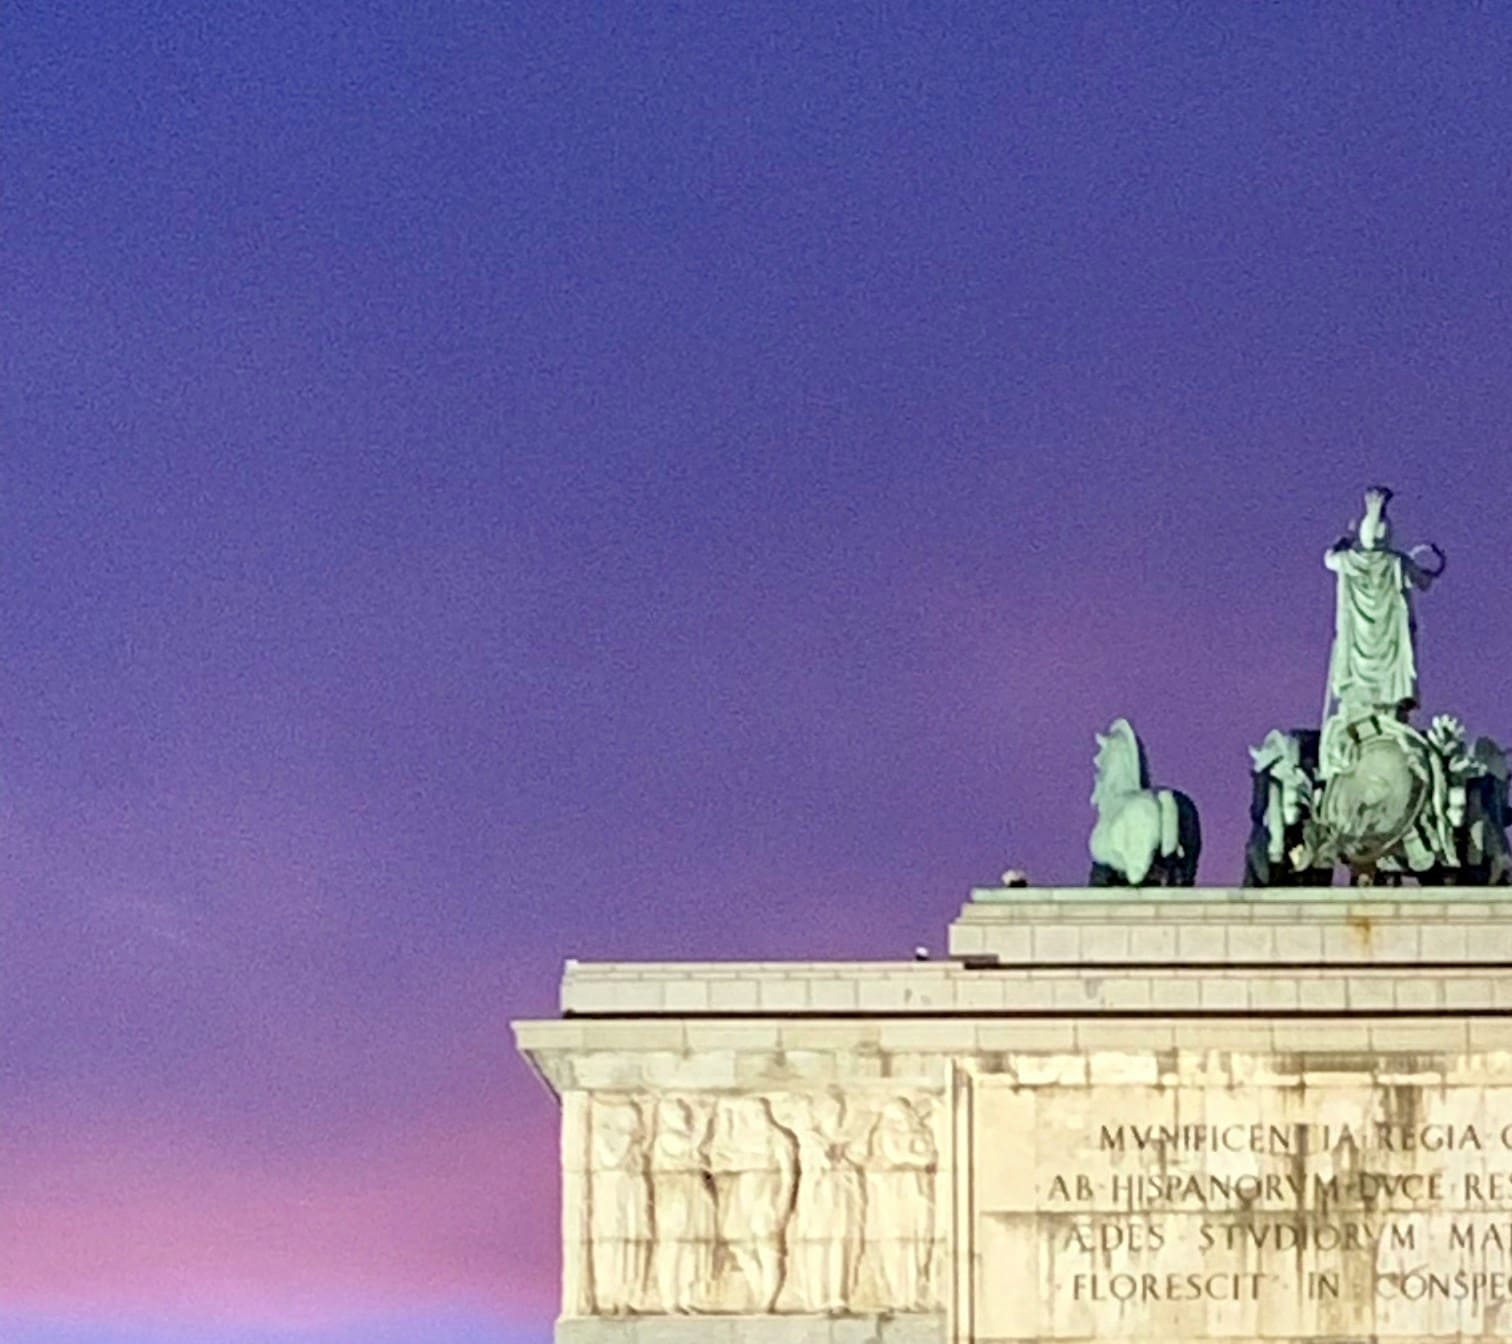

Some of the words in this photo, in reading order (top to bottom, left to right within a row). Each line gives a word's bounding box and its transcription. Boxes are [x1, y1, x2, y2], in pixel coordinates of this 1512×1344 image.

[1376, 1122, 1482, 1151] REGIA
[1048, 1174, 1094, 1202] AB
[1113, 1174, 1338, 1202] HISPANORVM
[1360, 1173, 1443, 1201] DVCE
[1199, 1222, 1415, 1252] STVDIORVM
[1074, 1273, 1266, 1301] FLORESCIT
[1308, 1272, 1340, 1300] IN
